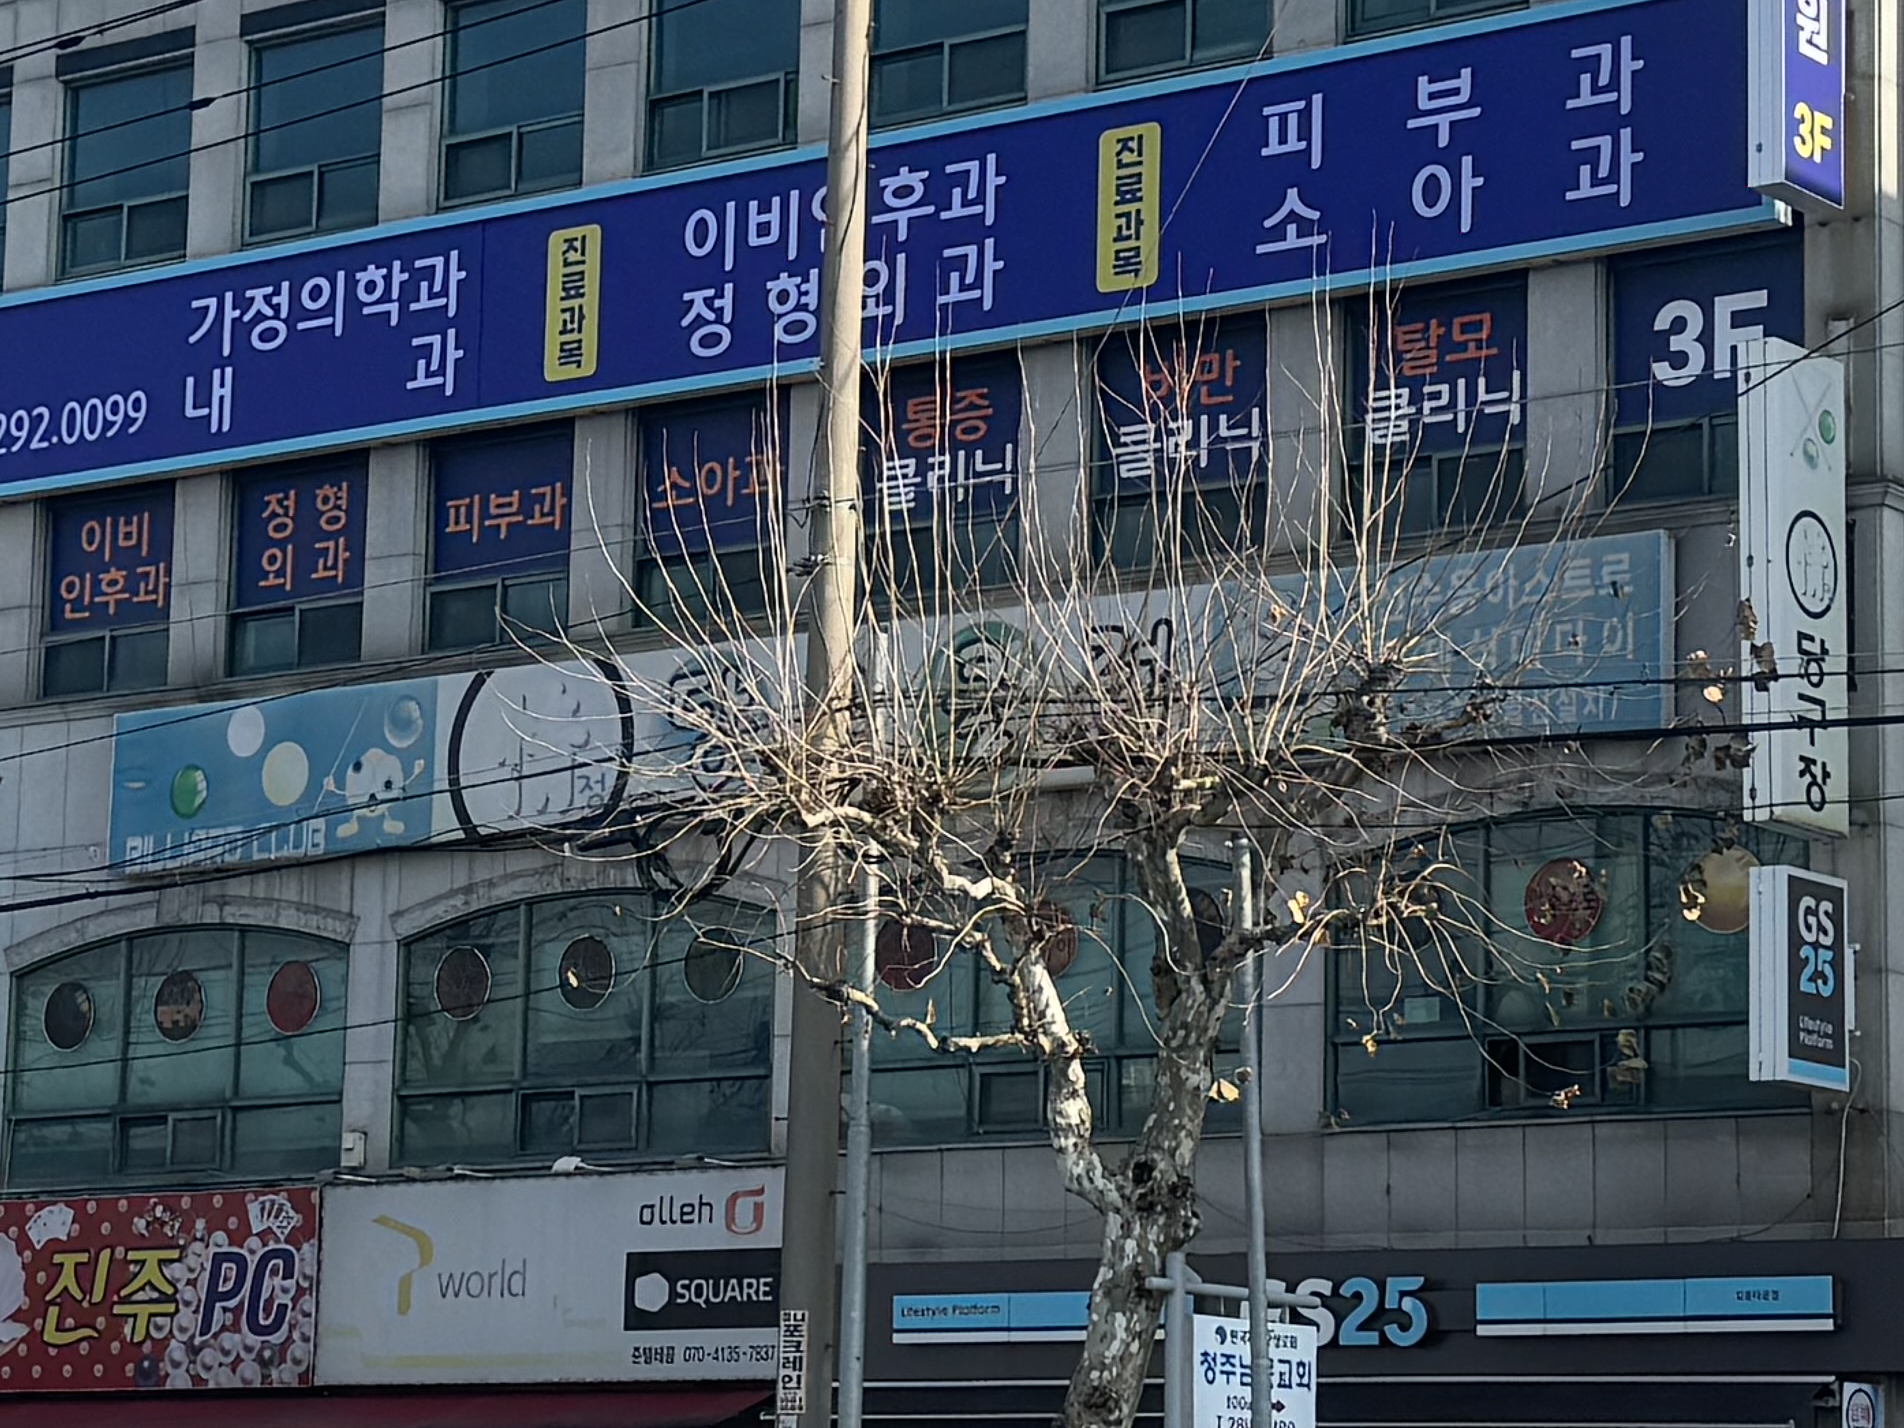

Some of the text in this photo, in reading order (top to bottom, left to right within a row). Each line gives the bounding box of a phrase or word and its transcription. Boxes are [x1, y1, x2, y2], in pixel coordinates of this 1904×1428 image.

[1261, 34, 1645, 171] 피부과
[1793, 100, 1833, 164] 3F
[1112, 134, 1146, 278] 진료과목
[1254, 126, 1645, 255] 소아과
[186, 249, 468, 358] 가정의학과
[556, 234, 588, 370] 진료과목
[1396, 310, 1499, 375] 탈모
[1652, 288, 1769, 387] 3F
[903, 388, 993, 450] 통증
[1366, 367, 1523, 444] 클리닉
[1116, 405, 1264, 478] 클리닉
[877, 442, 1016, 509] 클리닉
[80, 510, 153, 563] 이비
[260, 481, 350, 541] 정형
[445, 481, 568, 545] 피부과
[58, 561, 170, 621] 인후과
[257, 536, 351, 592] 외과
[1797, 895, 1835, 947] GS
[1798, 944, 1836, 998] 25
[639, 1193, 715, 1228] olleh
[197, 1242, 300, 1342] PC
[437, 1257, 528, 1301] world
[674, 1275, 774, 1306] SQUARE
[682, 1344, 776, 1363] 070-4135-7837
[1199, 1349, 1312, 1392] 청주남교회
